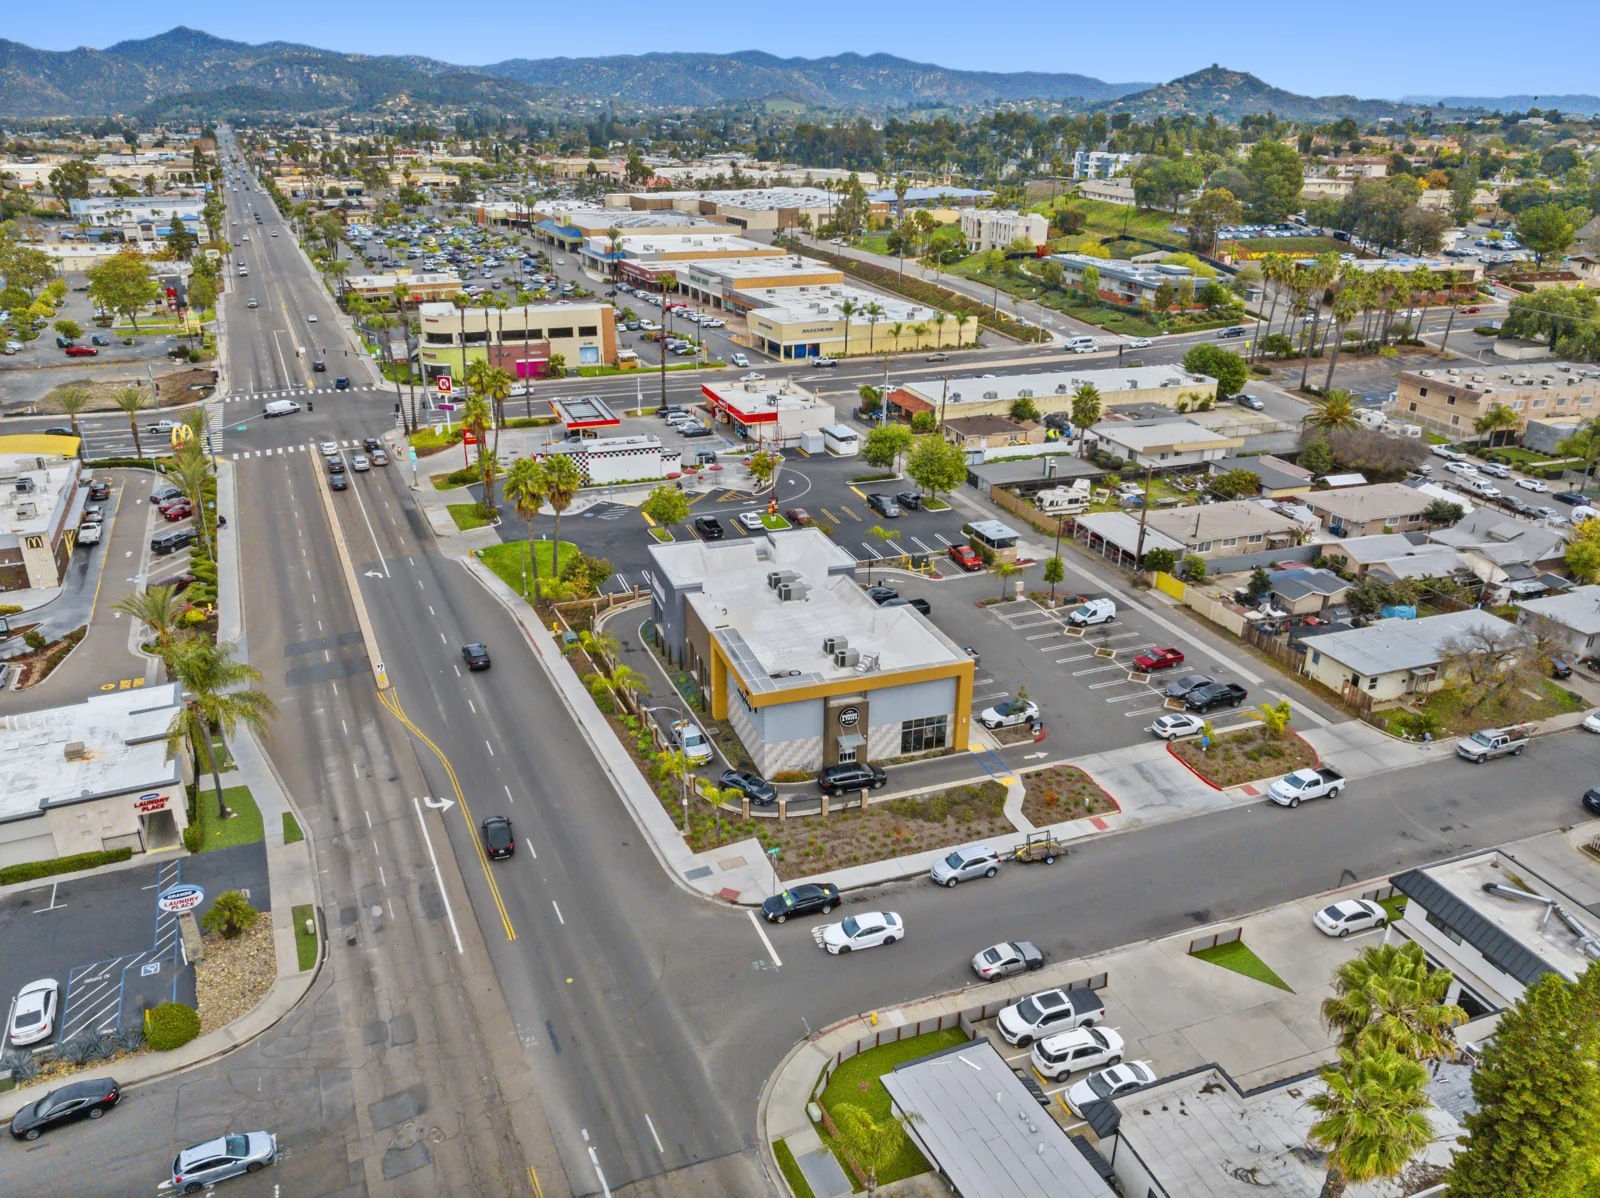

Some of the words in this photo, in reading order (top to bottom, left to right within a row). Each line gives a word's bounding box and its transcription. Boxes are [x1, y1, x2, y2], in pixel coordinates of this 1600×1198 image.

[134, 796, 170, 808] LAUNDRY
[141, 803, 165, 812] PLACE
[164, 896, 199, 907] LAUNDRY
[171, 902, 195, 910] PLACE
